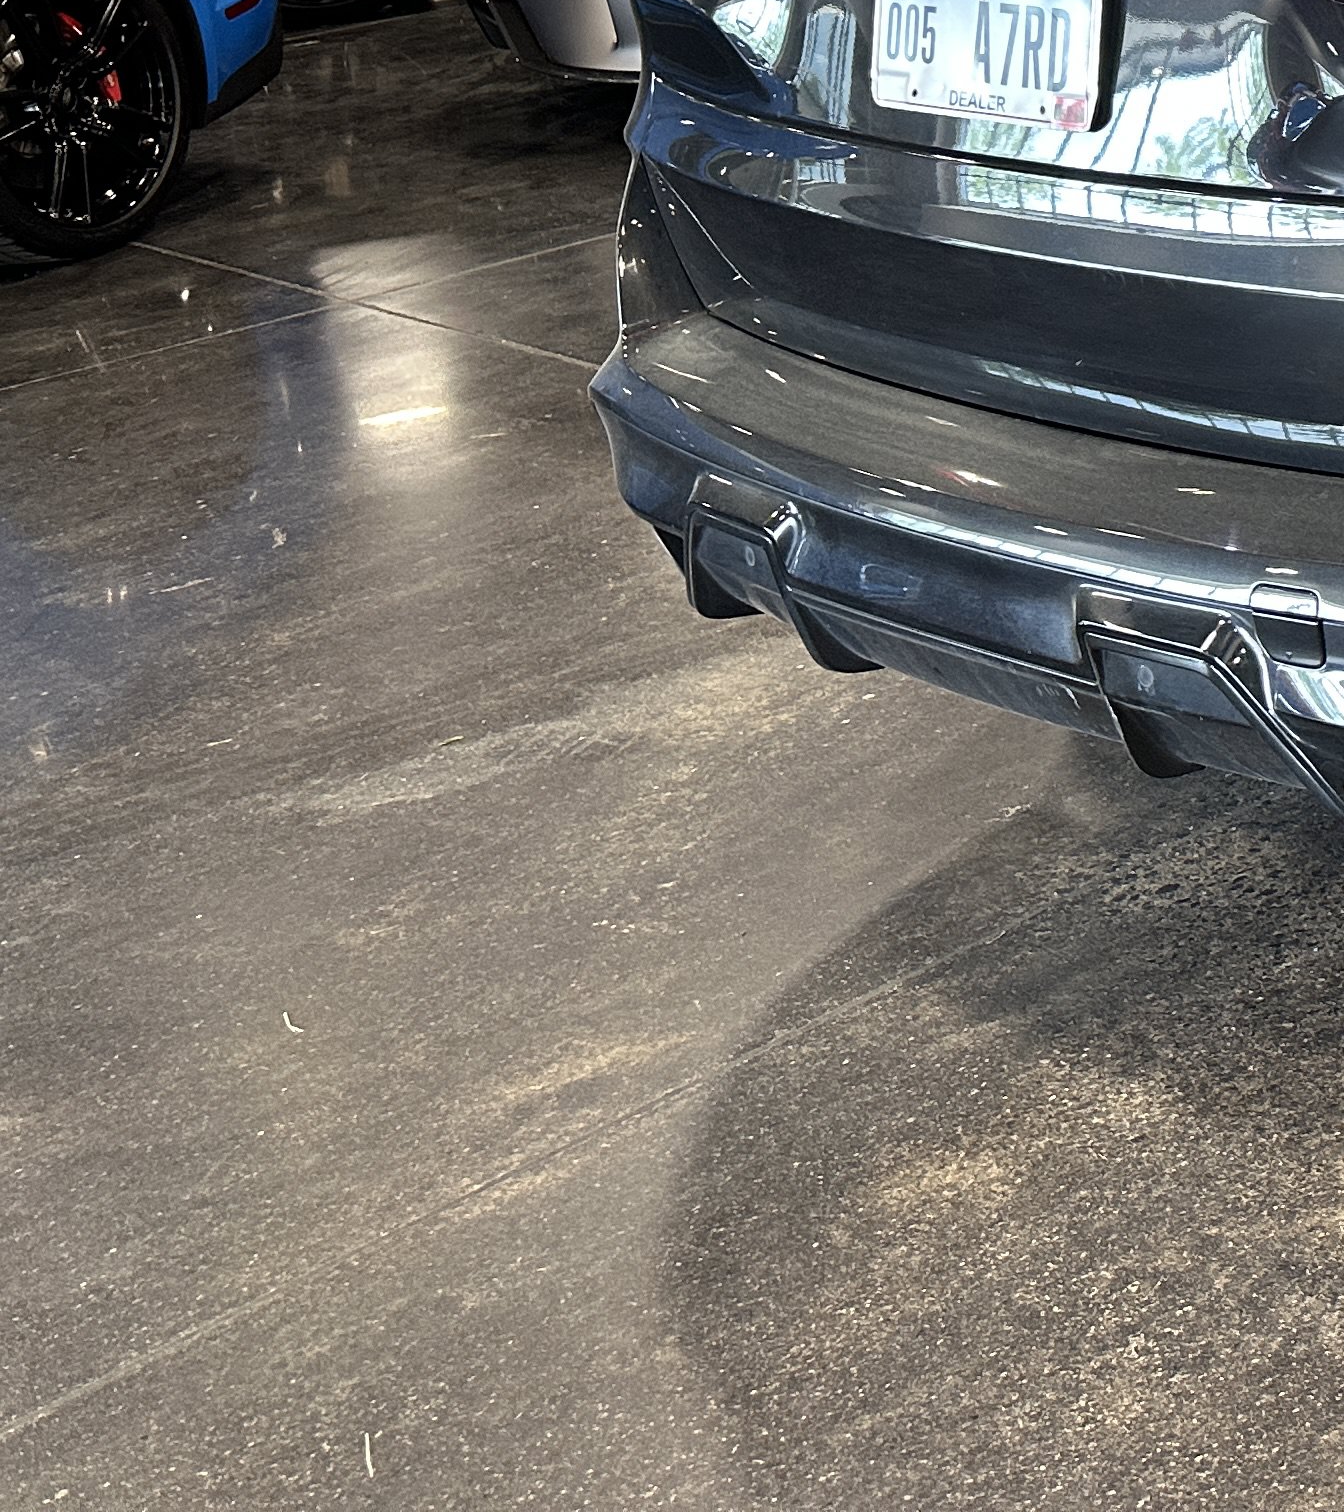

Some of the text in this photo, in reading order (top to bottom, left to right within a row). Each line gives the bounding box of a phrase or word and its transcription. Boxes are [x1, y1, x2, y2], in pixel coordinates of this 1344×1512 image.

[886, 1, 1072, 93] 005 A7RD
[949, 89, 1006, 114] DEALER
